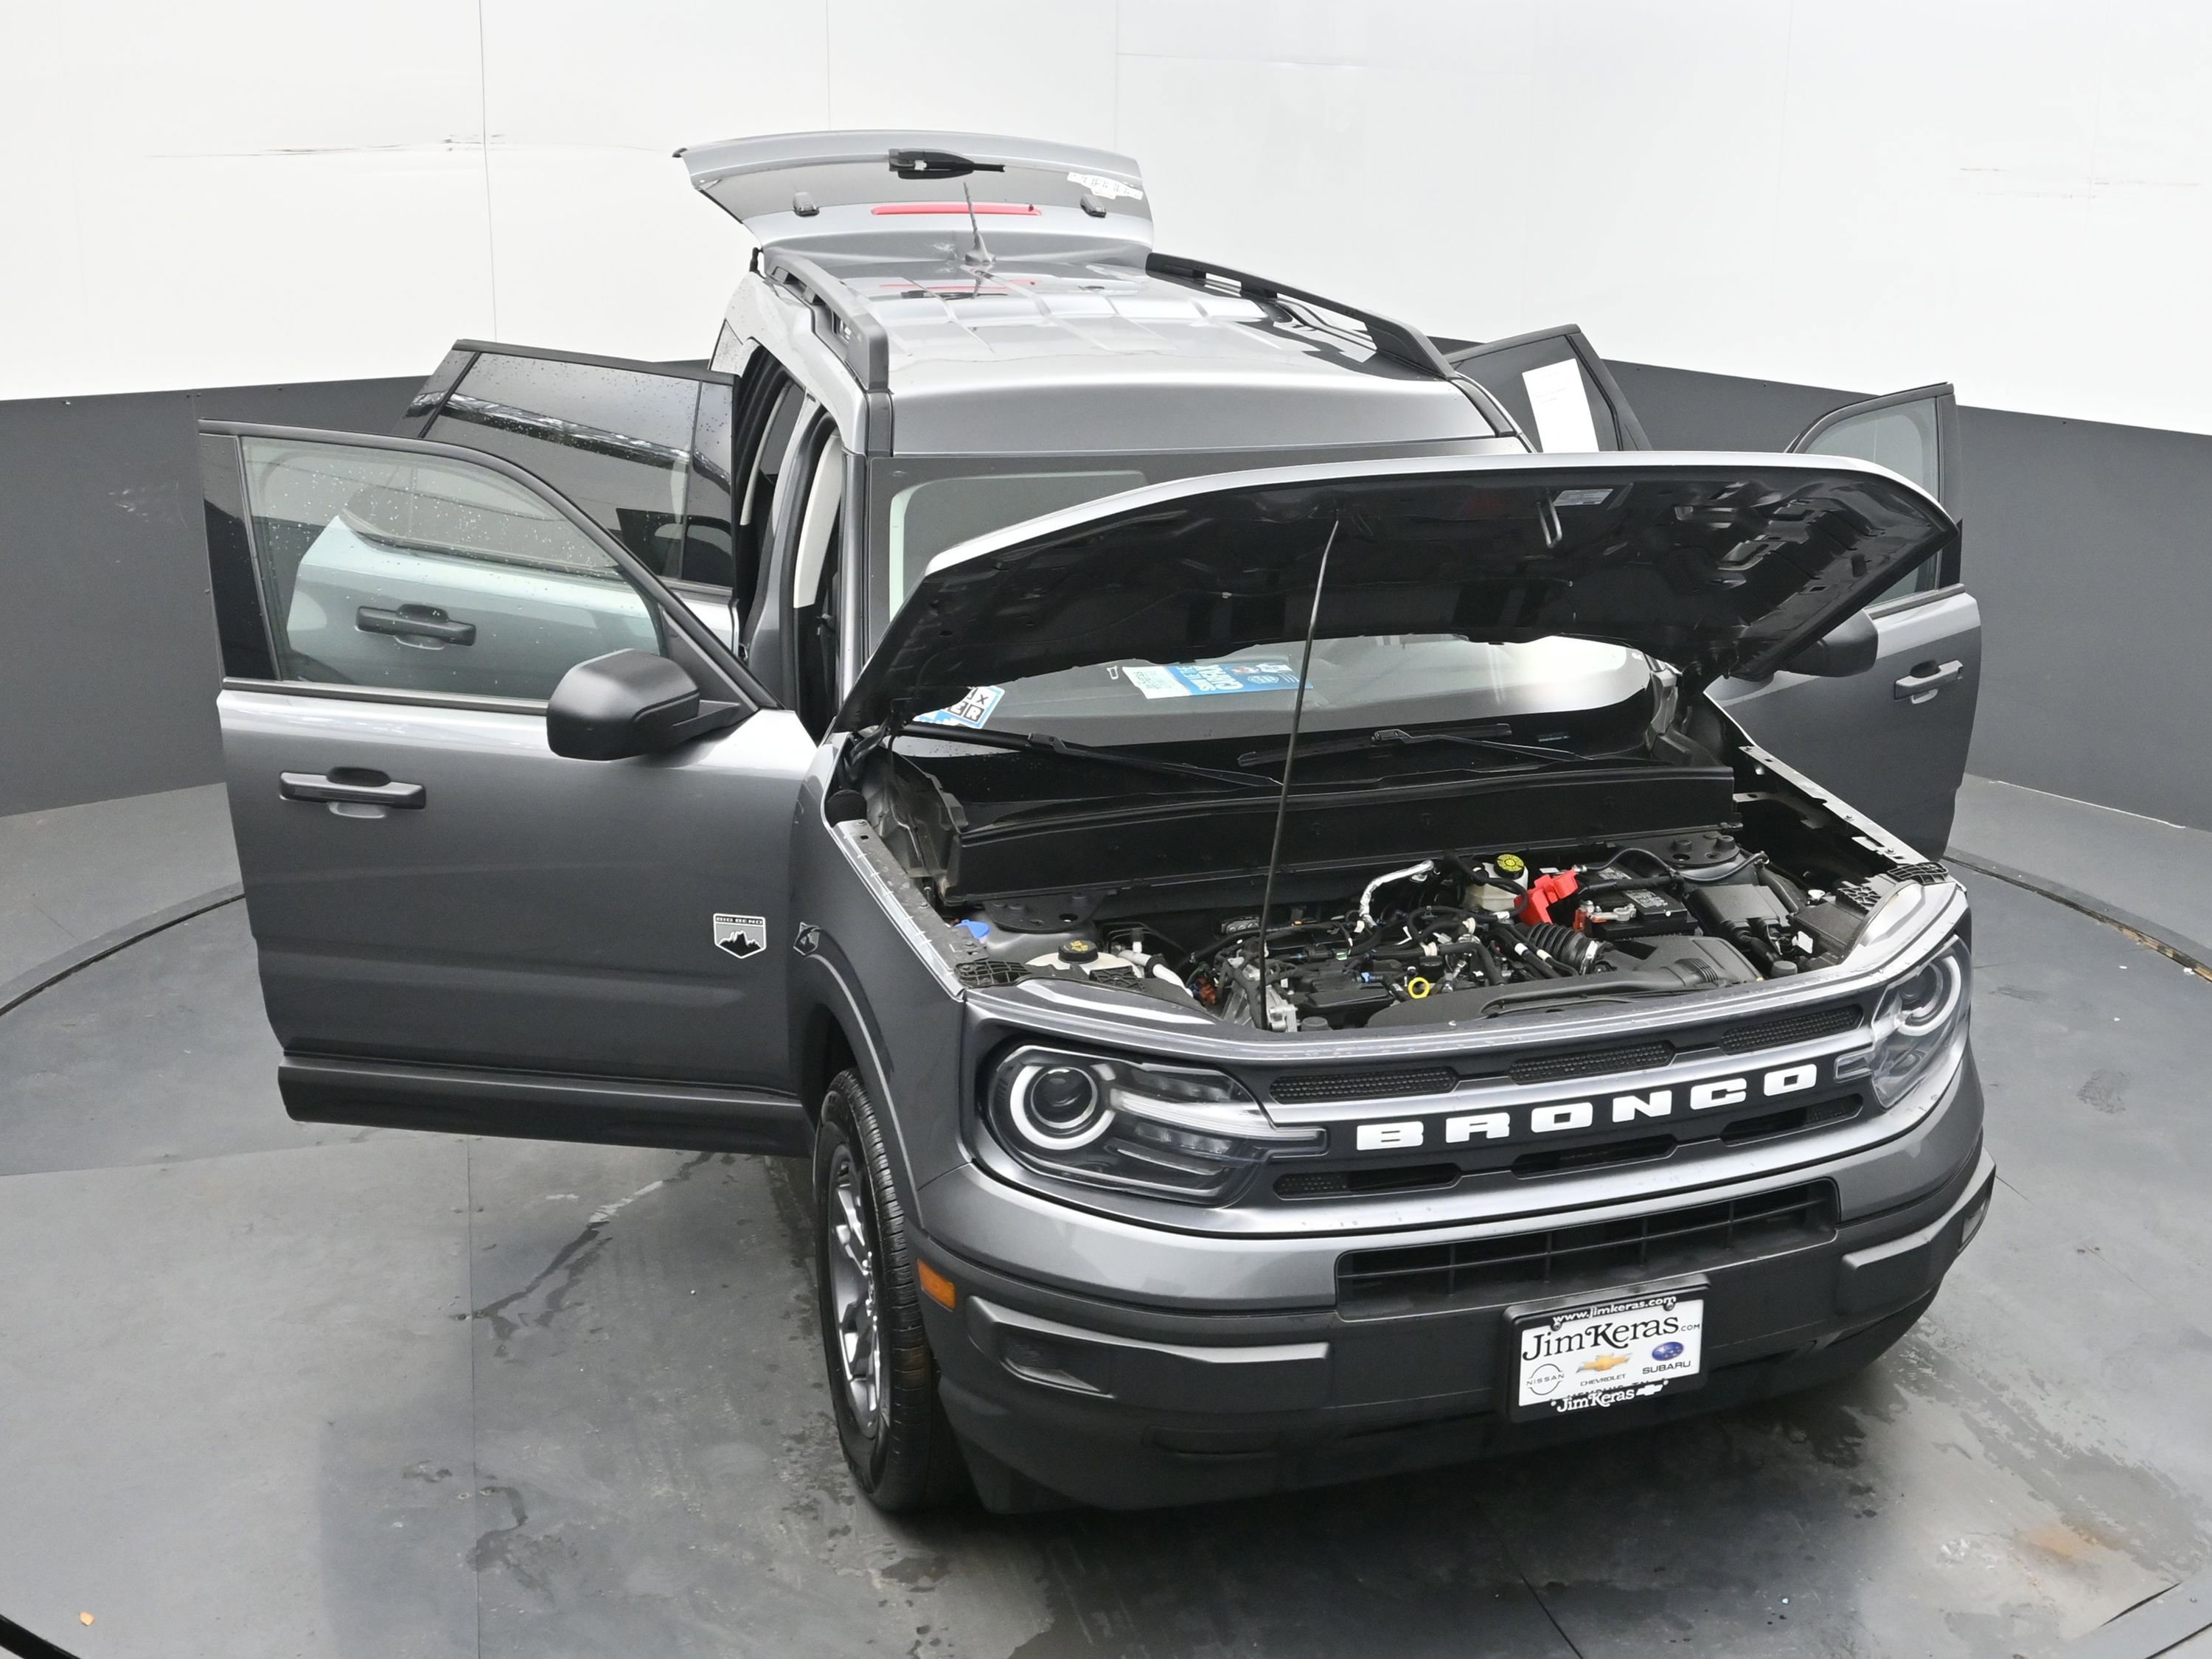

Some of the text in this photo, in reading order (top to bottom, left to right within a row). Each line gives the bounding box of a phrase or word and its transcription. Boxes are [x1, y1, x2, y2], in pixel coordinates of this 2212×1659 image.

[1357, 1064, 1817, 1151] BRONCO
[1552, 1296, 1676, 1323] www.jimkeras.com
[1642, 1360, 1691, 1374] SUBARU
[1526, 1373, 1565, 1386] NISSAN
[1580, 1373, 1626, 1386] CHEVROLET
